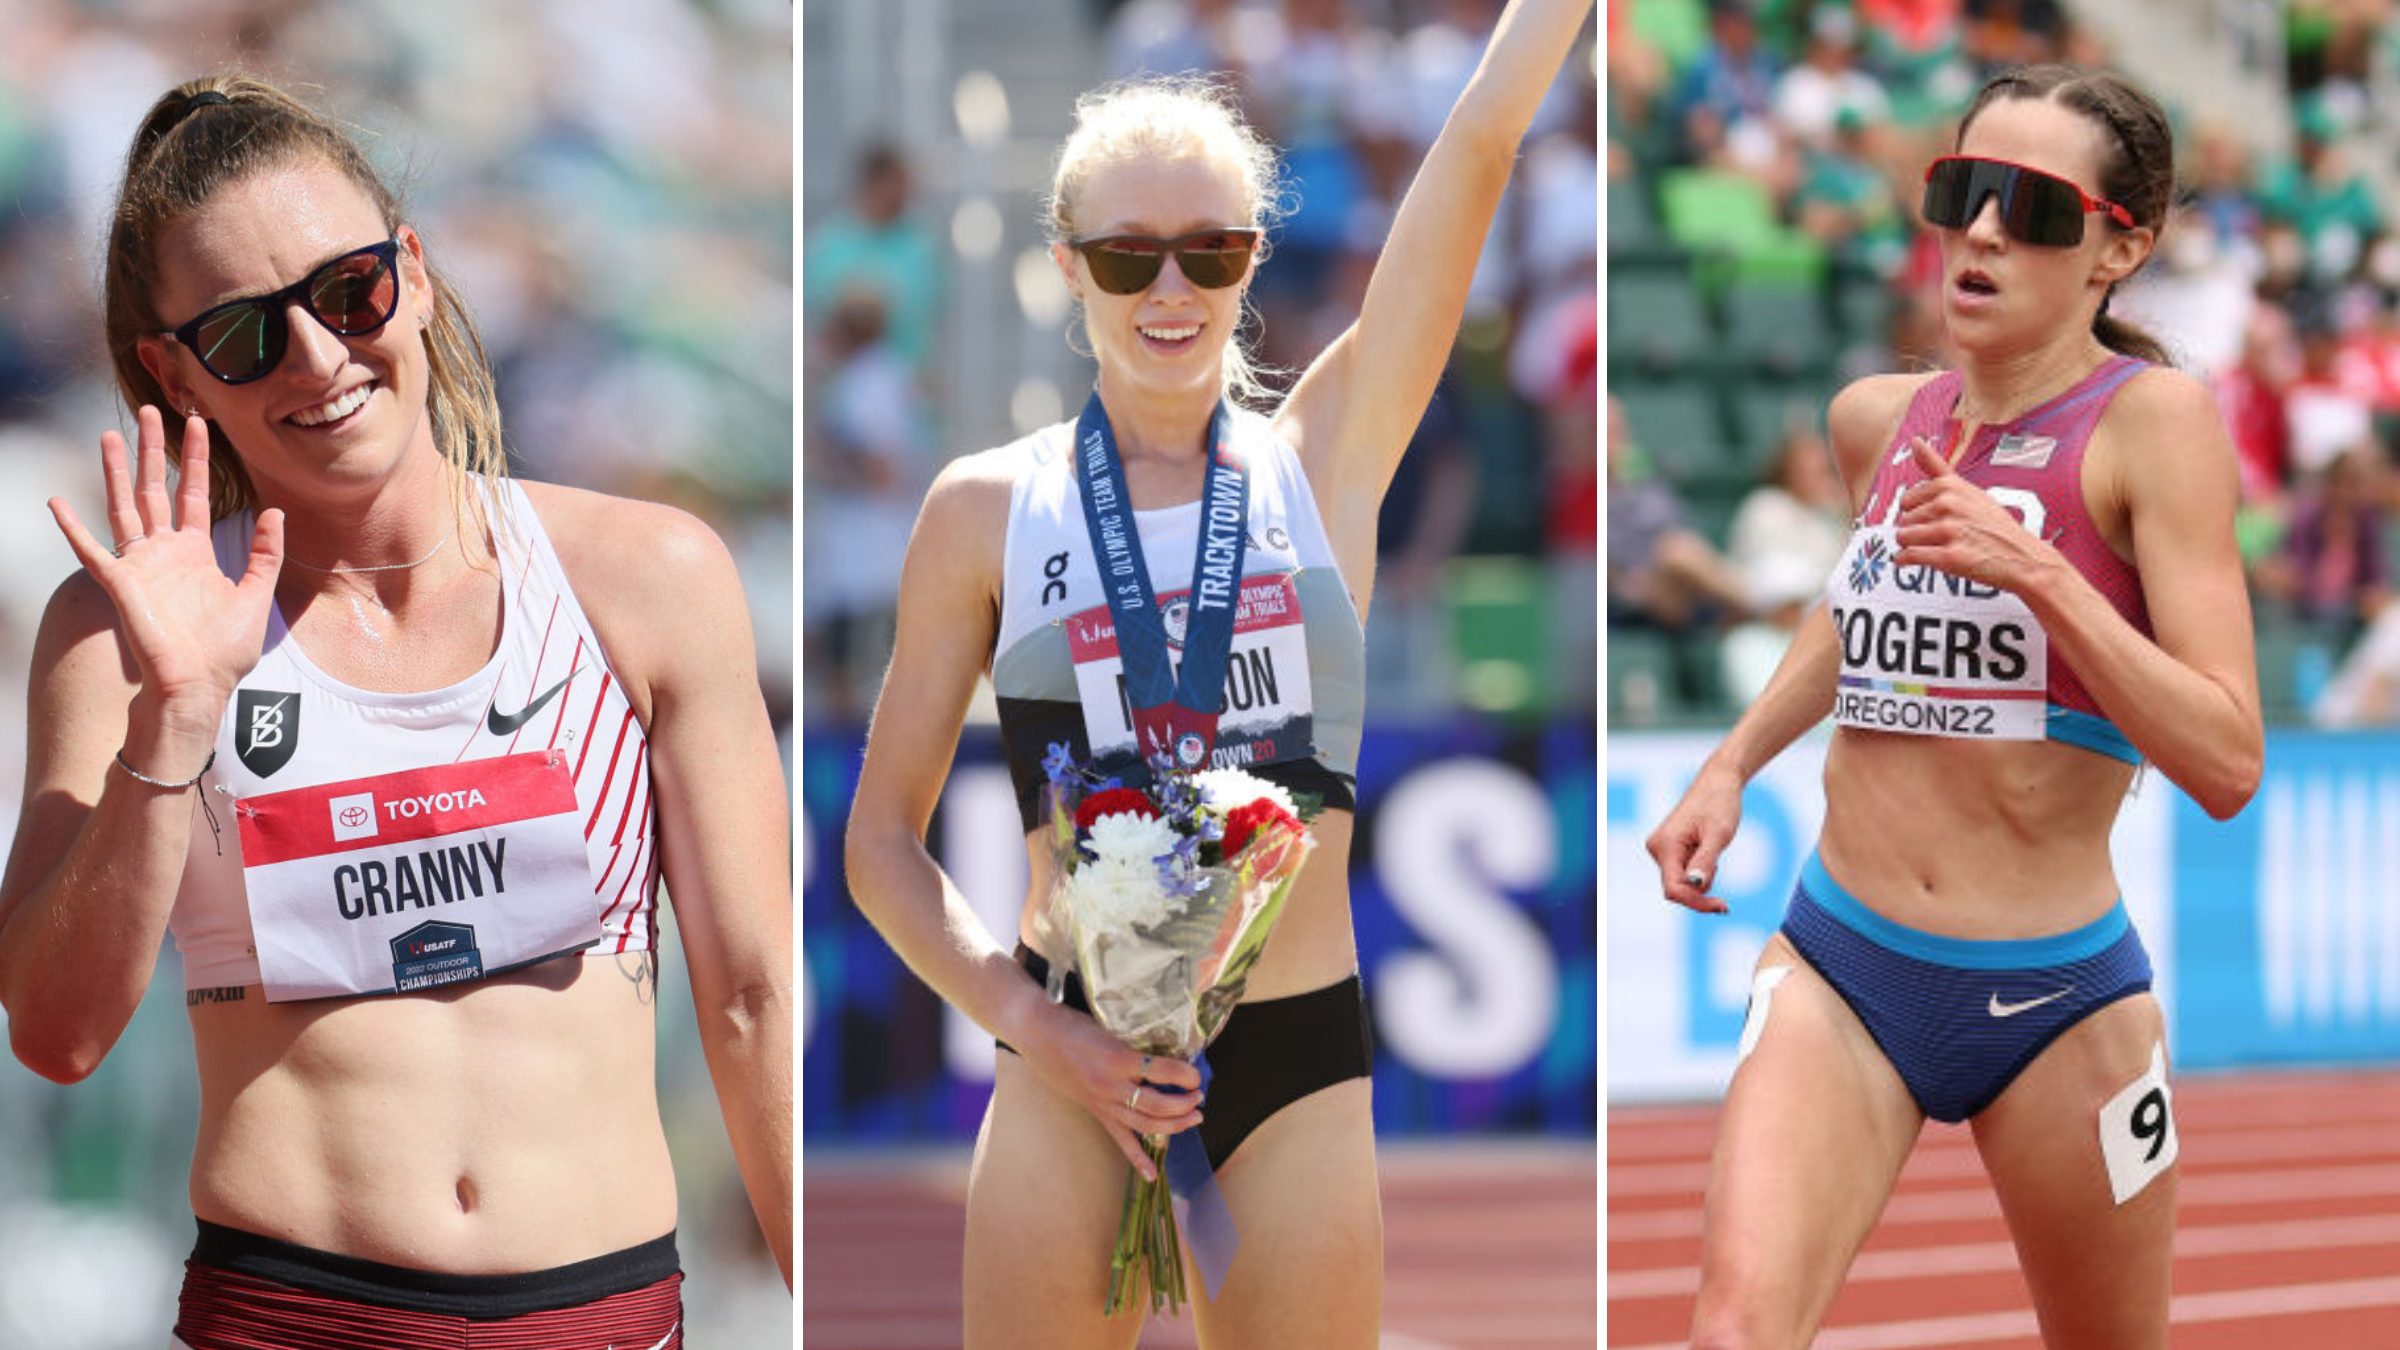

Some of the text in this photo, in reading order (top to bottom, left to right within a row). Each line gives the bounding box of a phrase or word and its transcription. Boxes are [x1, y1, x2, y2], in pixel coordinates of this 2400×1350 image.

[1084, 430, 1109, 477] TRIALS
[1092, 475, 1117, 515] TEAM
[1100, 514, 1134, 576] OLYMPIC
[1253, 600, 1287, 618] TRIALS
[384, 788, 487, 820] TOYOTA
[333, 837, 507, 921] CRANNY
[424, 939, 456, 953] USATF
[427, 956, 469, 971] OUTDOOR
[400, 966, 479, 991] CHAMPIONSHIPS
[2130, 1087, 2167, 1164] 9
